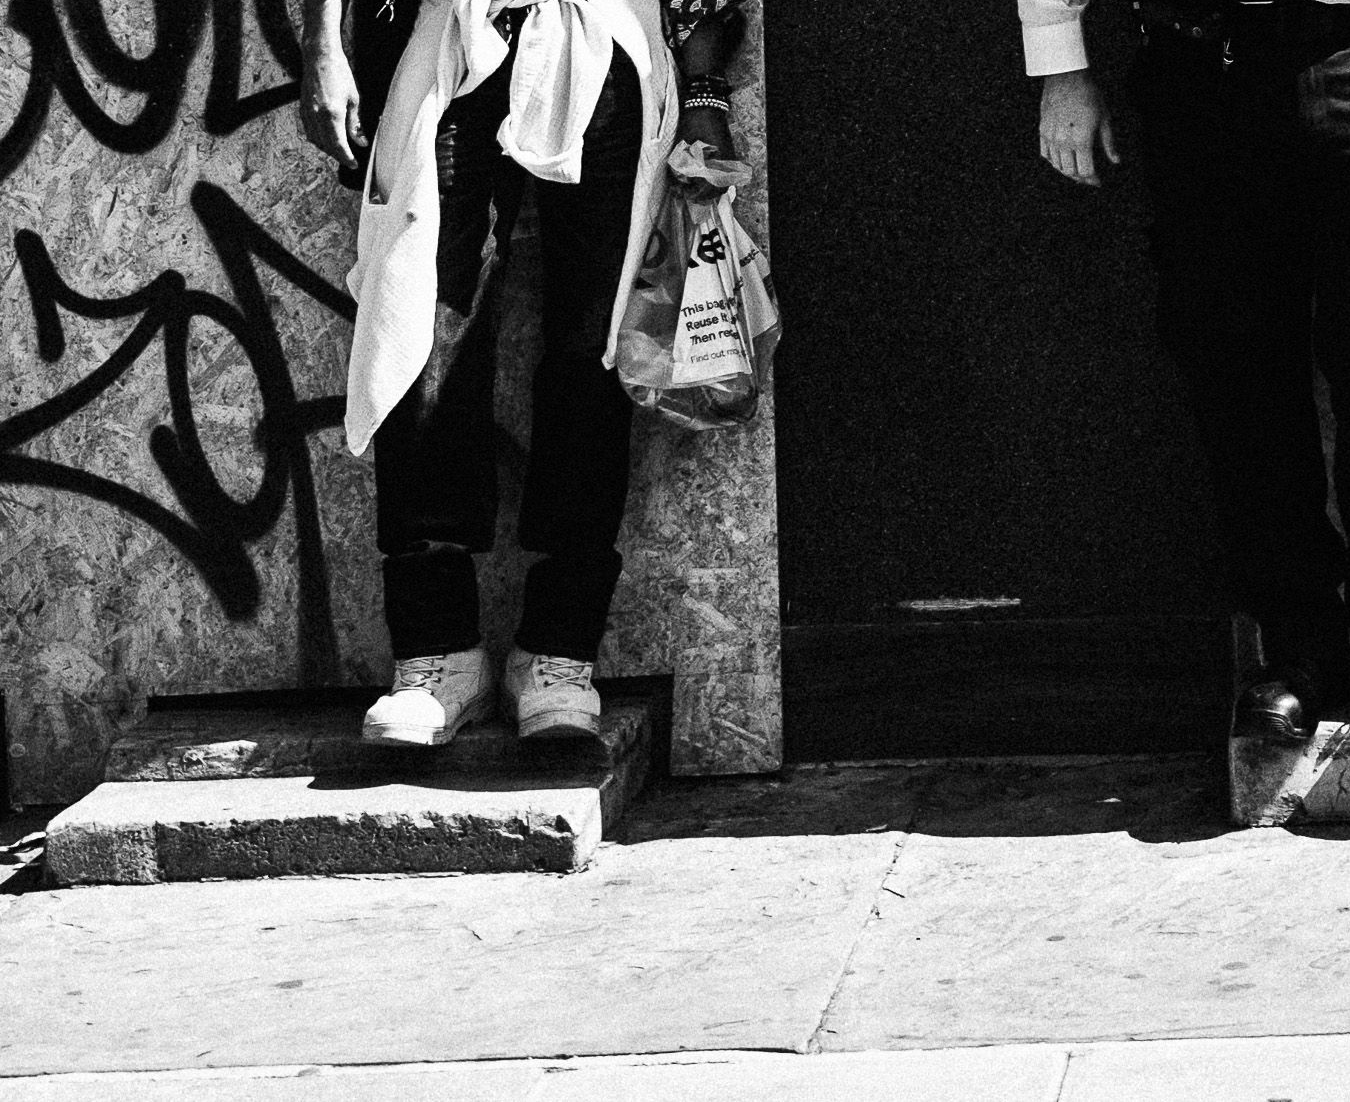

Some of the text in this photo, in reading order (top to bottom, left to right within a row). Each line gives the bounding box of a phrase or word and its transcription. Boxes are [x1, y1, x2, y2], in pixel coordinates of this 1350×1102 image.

[681, 303, 705, 317] This
[706, 299, 725, 310] bag
[686, 316, 719, 332] Reuse
[689, 332, 716, 346] Then
[690, 353, 709, 363] Find
[711, 351, 726, 360] out
